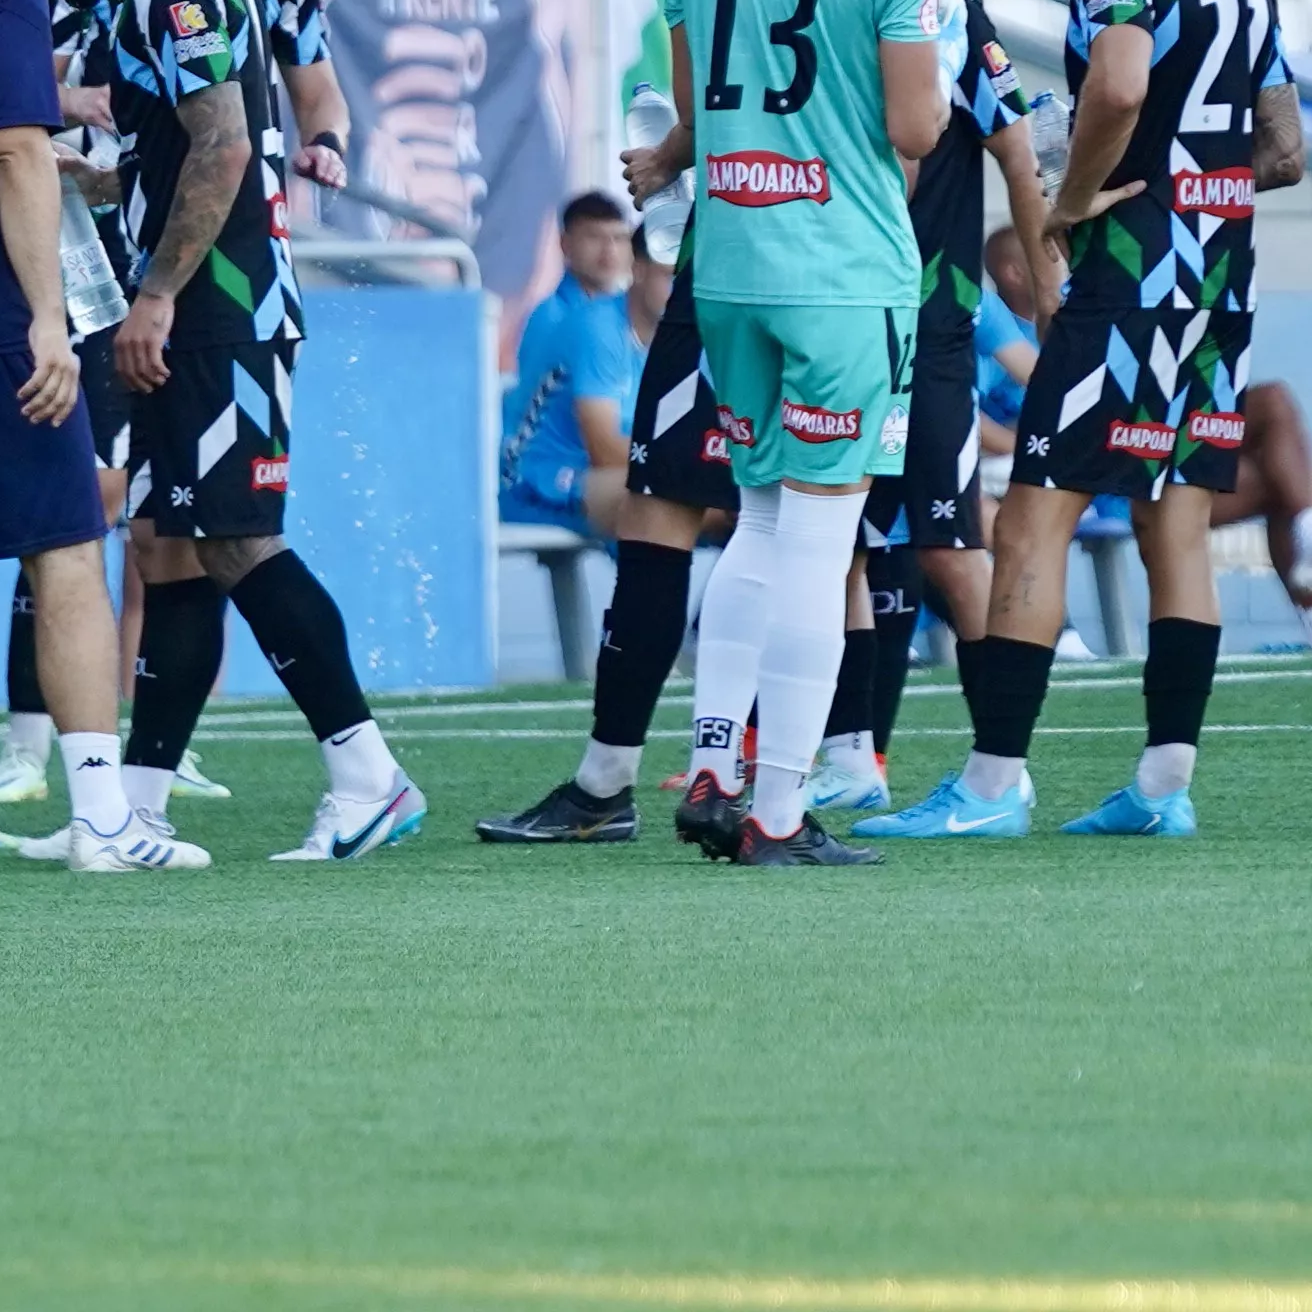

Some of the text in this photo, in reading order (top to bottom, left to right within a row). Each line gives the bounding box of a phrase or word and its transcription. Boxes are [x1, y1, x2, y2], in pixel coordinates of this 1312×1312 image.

[708, 161, 823, 194] AMPOARAS
[1179, 177, 1255, 207] CAMPOA
[870, 588, 916, 614] DL
